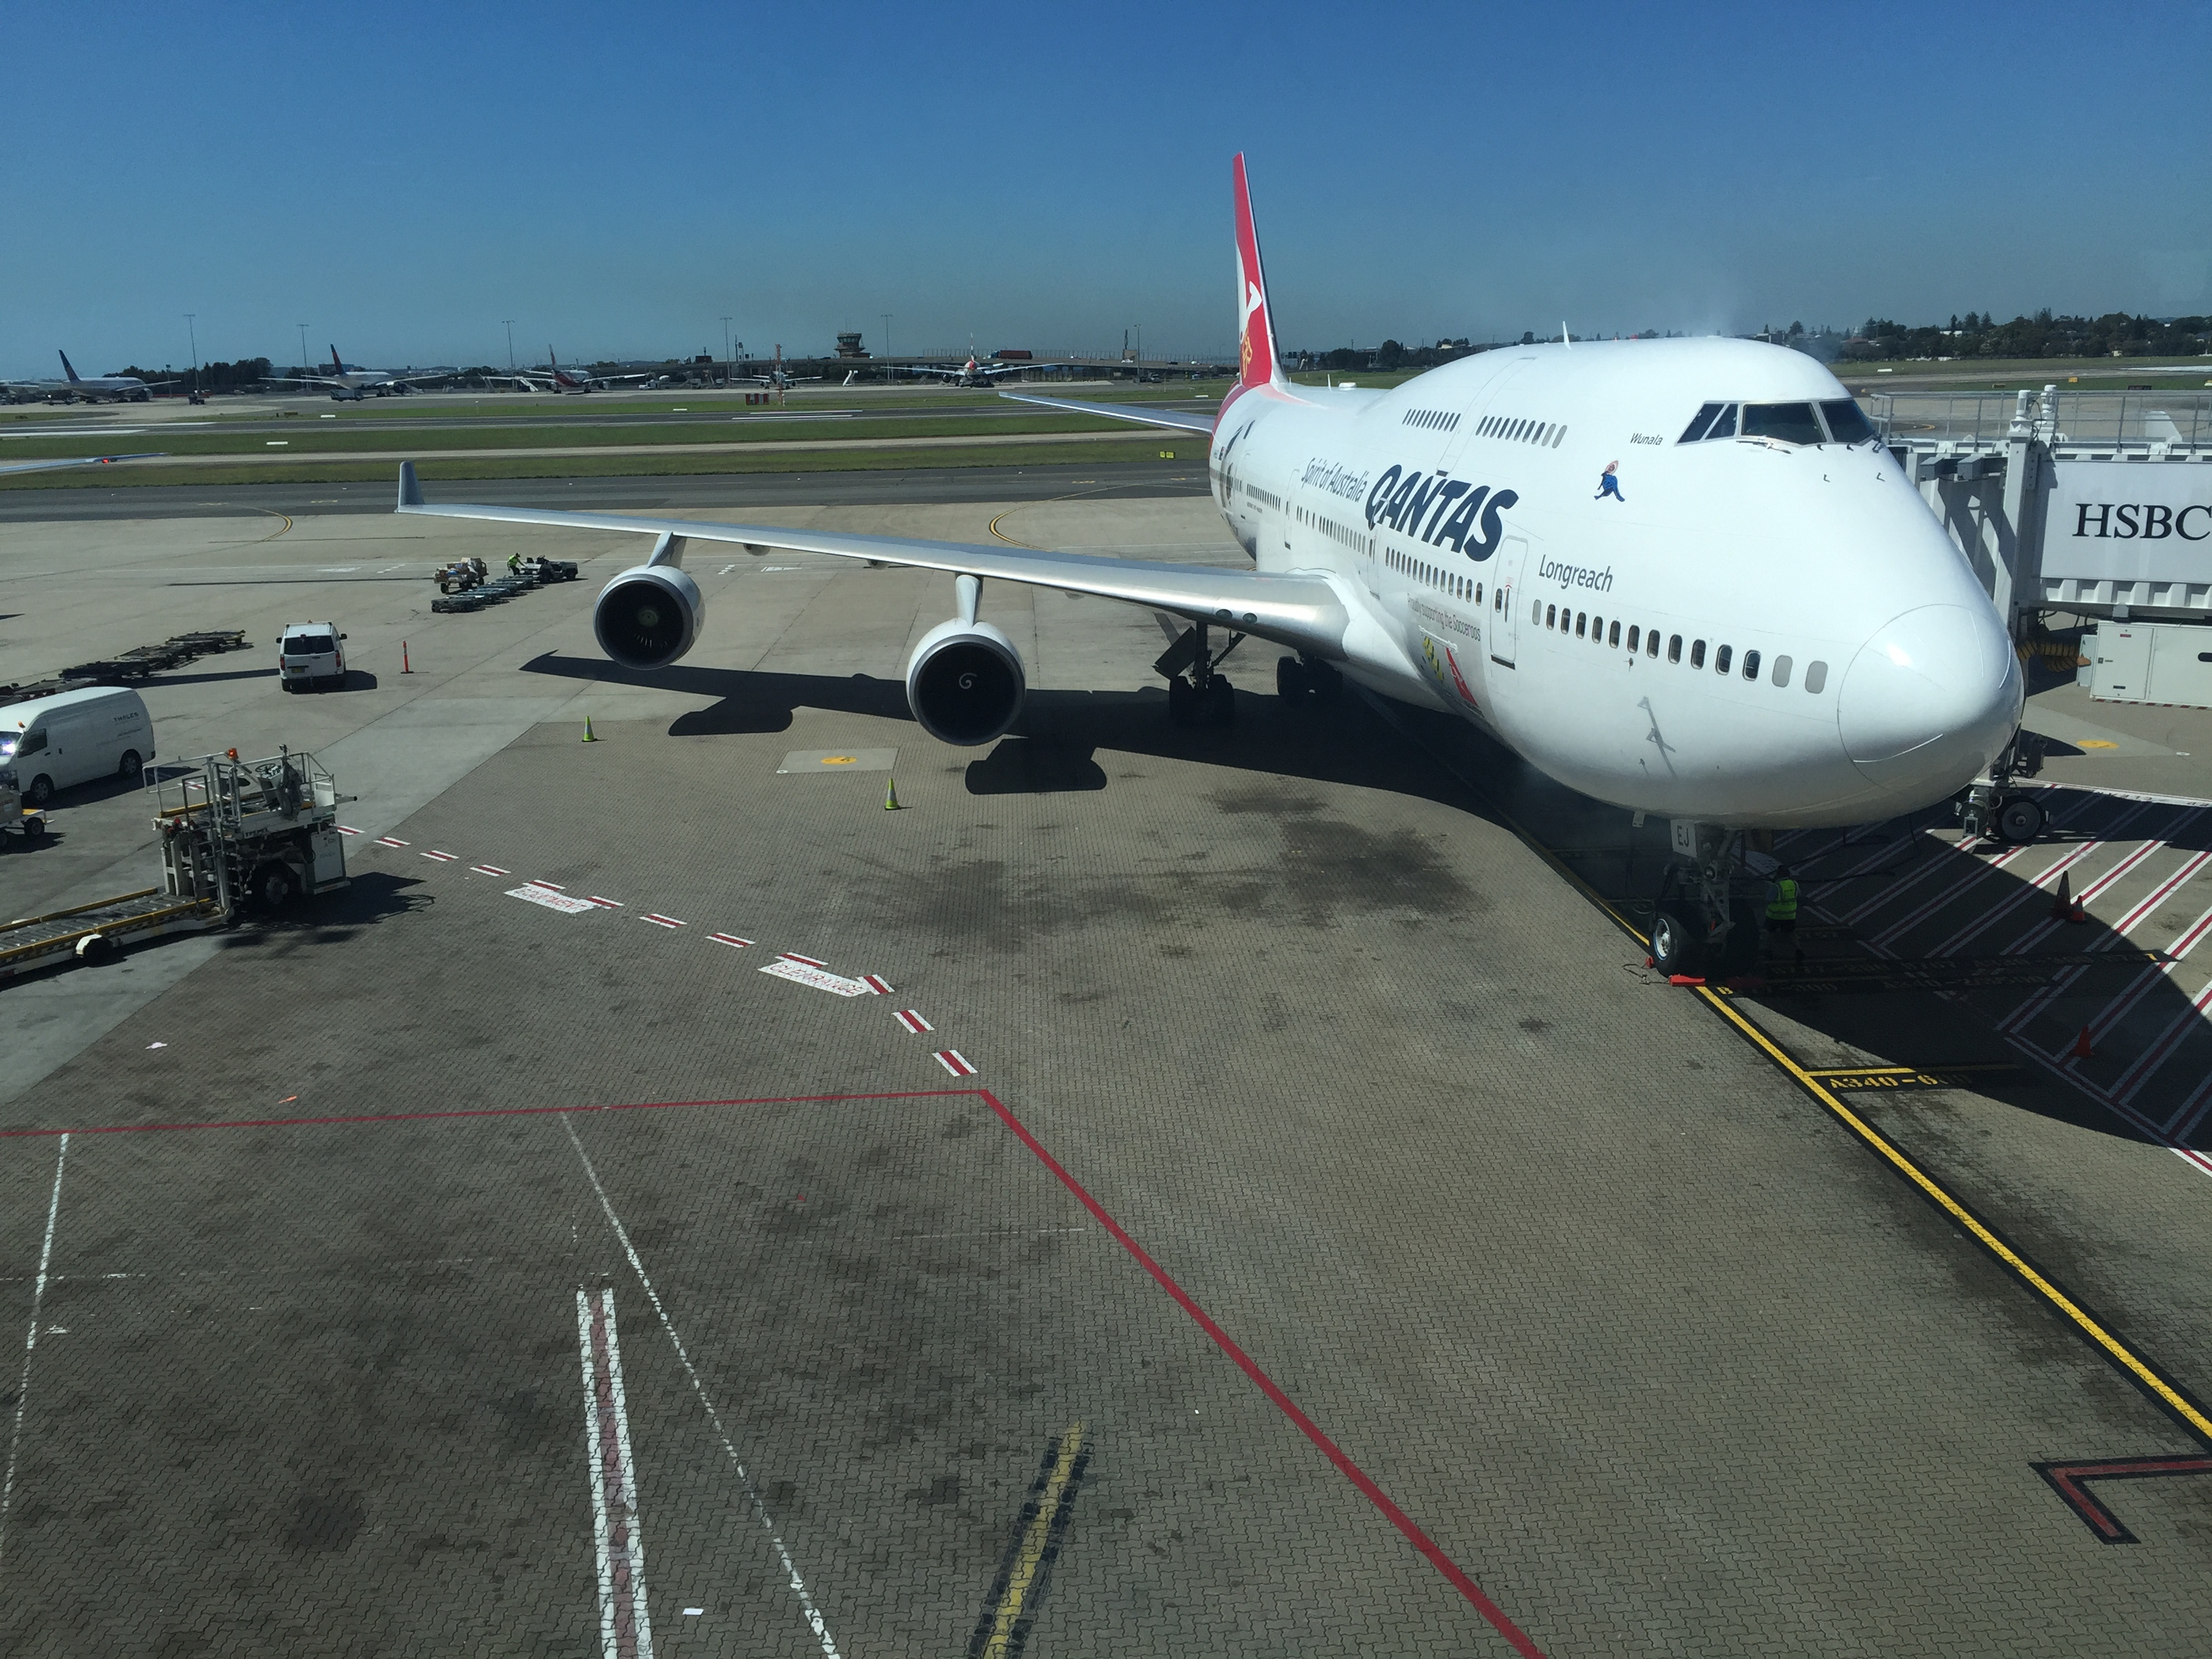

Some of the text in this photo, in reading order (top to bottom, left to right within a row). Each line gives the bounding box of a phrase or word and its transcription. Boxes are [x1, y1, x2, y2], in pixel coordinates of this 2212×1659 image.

[1630, 432, 1663, 445] Wunala
[1301, 457, 1370, 502] Spirit of Australia
[1365, 464, 1519, 562] QANTAS
[2072, 503, 2212, 540] HSBC
[1538, 554, 1614, 592] Longreach
[1422, 604, 1445, 630] supporting
[1444, 611, 1452, 629] the
[1452, 614, 1481, 642] Socceroos
[113, 712, 140, 722] THALES
[1677, 825, 1689, 848] EJ
[769, 964, 868, 995] CLEARANCE
